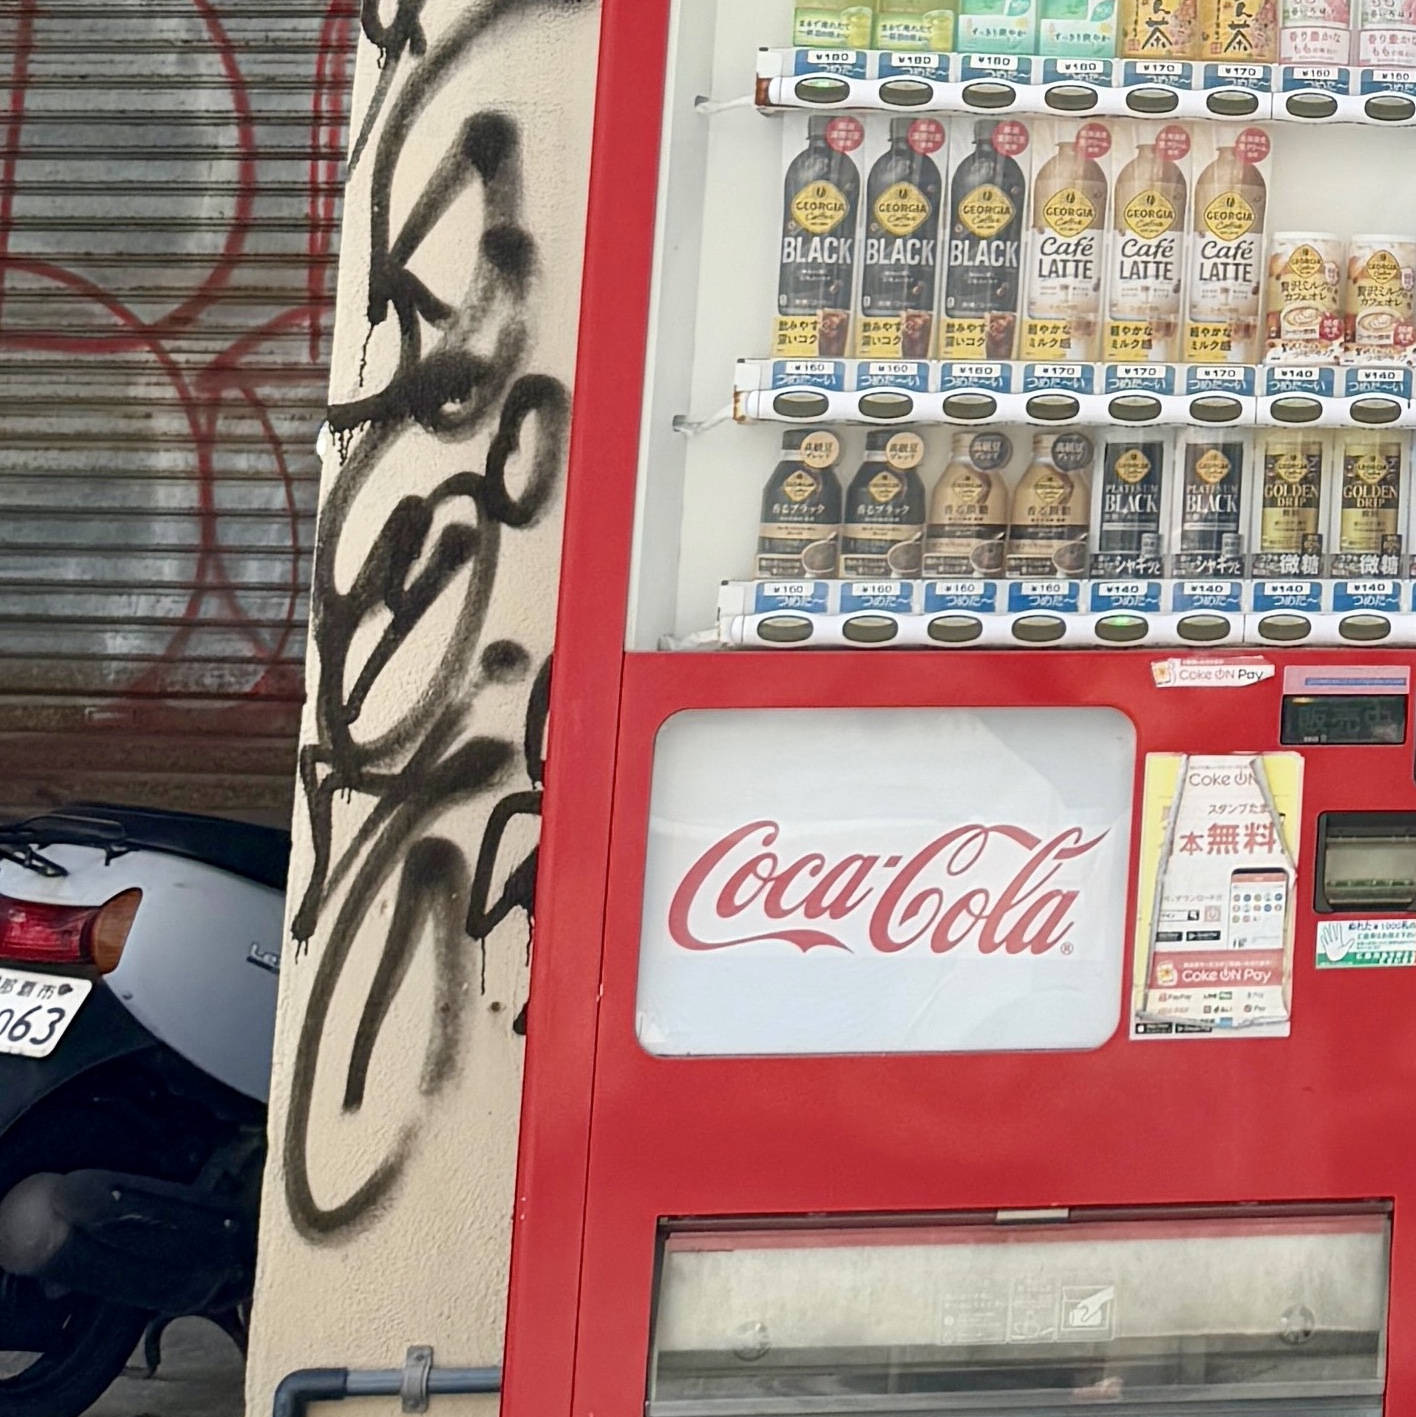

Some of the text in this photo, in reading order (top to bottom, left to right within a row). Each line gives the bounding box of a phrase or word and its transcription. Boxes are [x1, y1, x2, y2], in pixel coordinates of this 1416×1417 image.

[796, 201, 845, 212] GEORGIA
[879, 203, 927, 214] GEORGIA
[962, 203, 1011, 216] GEORGIA
[1046, 207, 1093, 217] GEORGIA
[1127, 209, 1173, 219] GEORGIA
[1207, 211, 1254, 221] GEORGIA
[783, 237, 852, 264] BLACK
[866, 238, 934, 265] BLACK
[950, 240, 1018, 267] BLACK
[1040, 237, 1094, 257] Café
[1121, 239, 1174, 258] Café
[1201, 241, 1252, 260] Café
[1039, 259, 1093, 279] LATTE
[1120, 261, 1173, 280] LATTE
[1200, 263, 1252, 282] LATTE
[1264, 485, 1318, 499] GOLDEN
[1344, 486, 1397, 498] GOLDEN
[1105, 494, 1157, 512] BLACK
[1186, 494, 1237, 512] BLACK
[1276, 497, 1306, 507] DRIP
[1356, 497, 1384, 507] DRIP
[1360, 556, 1399, 575] 微糖
[1180, 669, 1212, 680] Coke
[1238, 669, 1263, 681] Pay
[1189, 773, 1231, 786] Coke
[668, 820, 1111, 955] Coca-Cola
[1182, 970, 1217, 982] Coke
[1244, 969, 1271, 983] Pay
